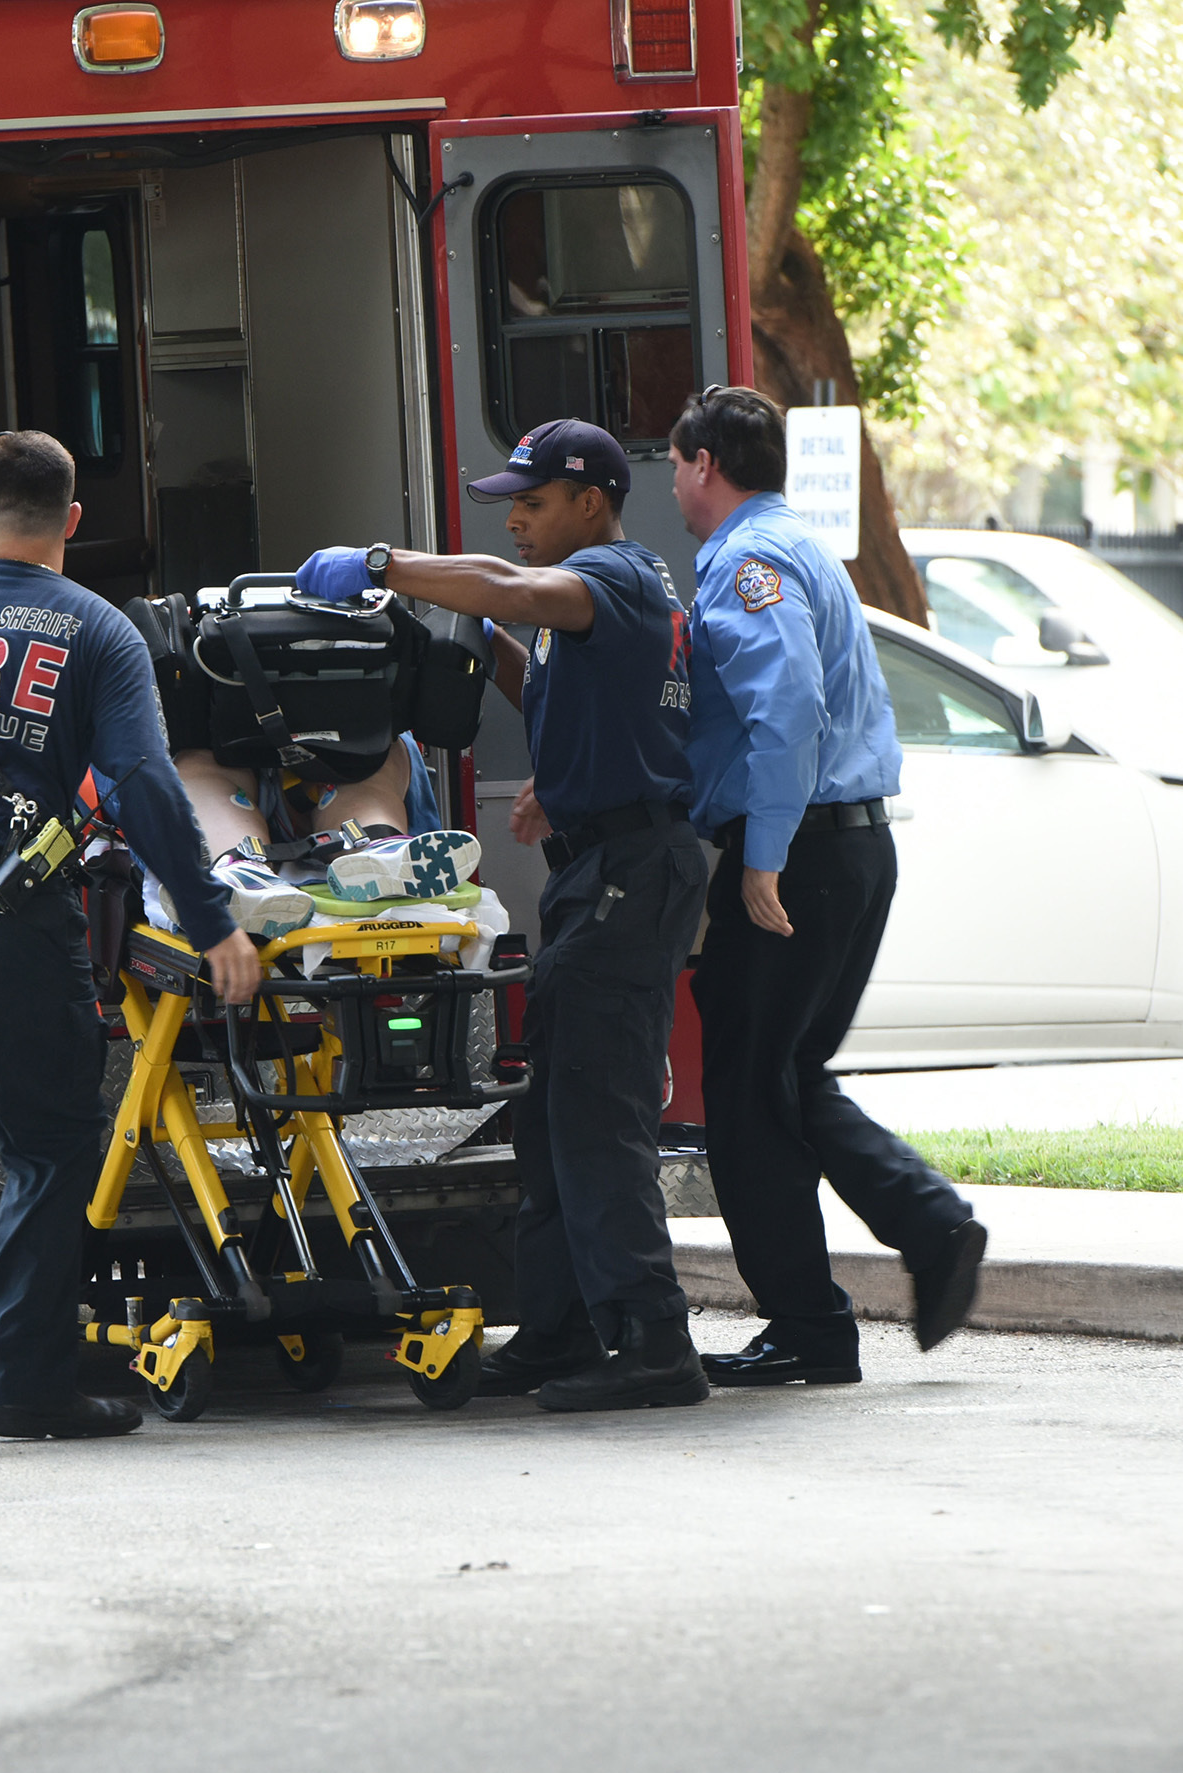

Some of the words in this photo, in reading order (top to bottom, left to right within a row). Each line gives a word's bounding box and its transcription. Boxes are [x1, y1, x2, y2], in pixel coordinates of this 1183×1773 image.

[800, 437, 845, 456] DETAIL
[794, 472, 852, 493] OFFICER
[799, 509, 851, 528] RKING
[362, 921, 416, 932] RUGGED
[376, 940, 396, 951] R17
